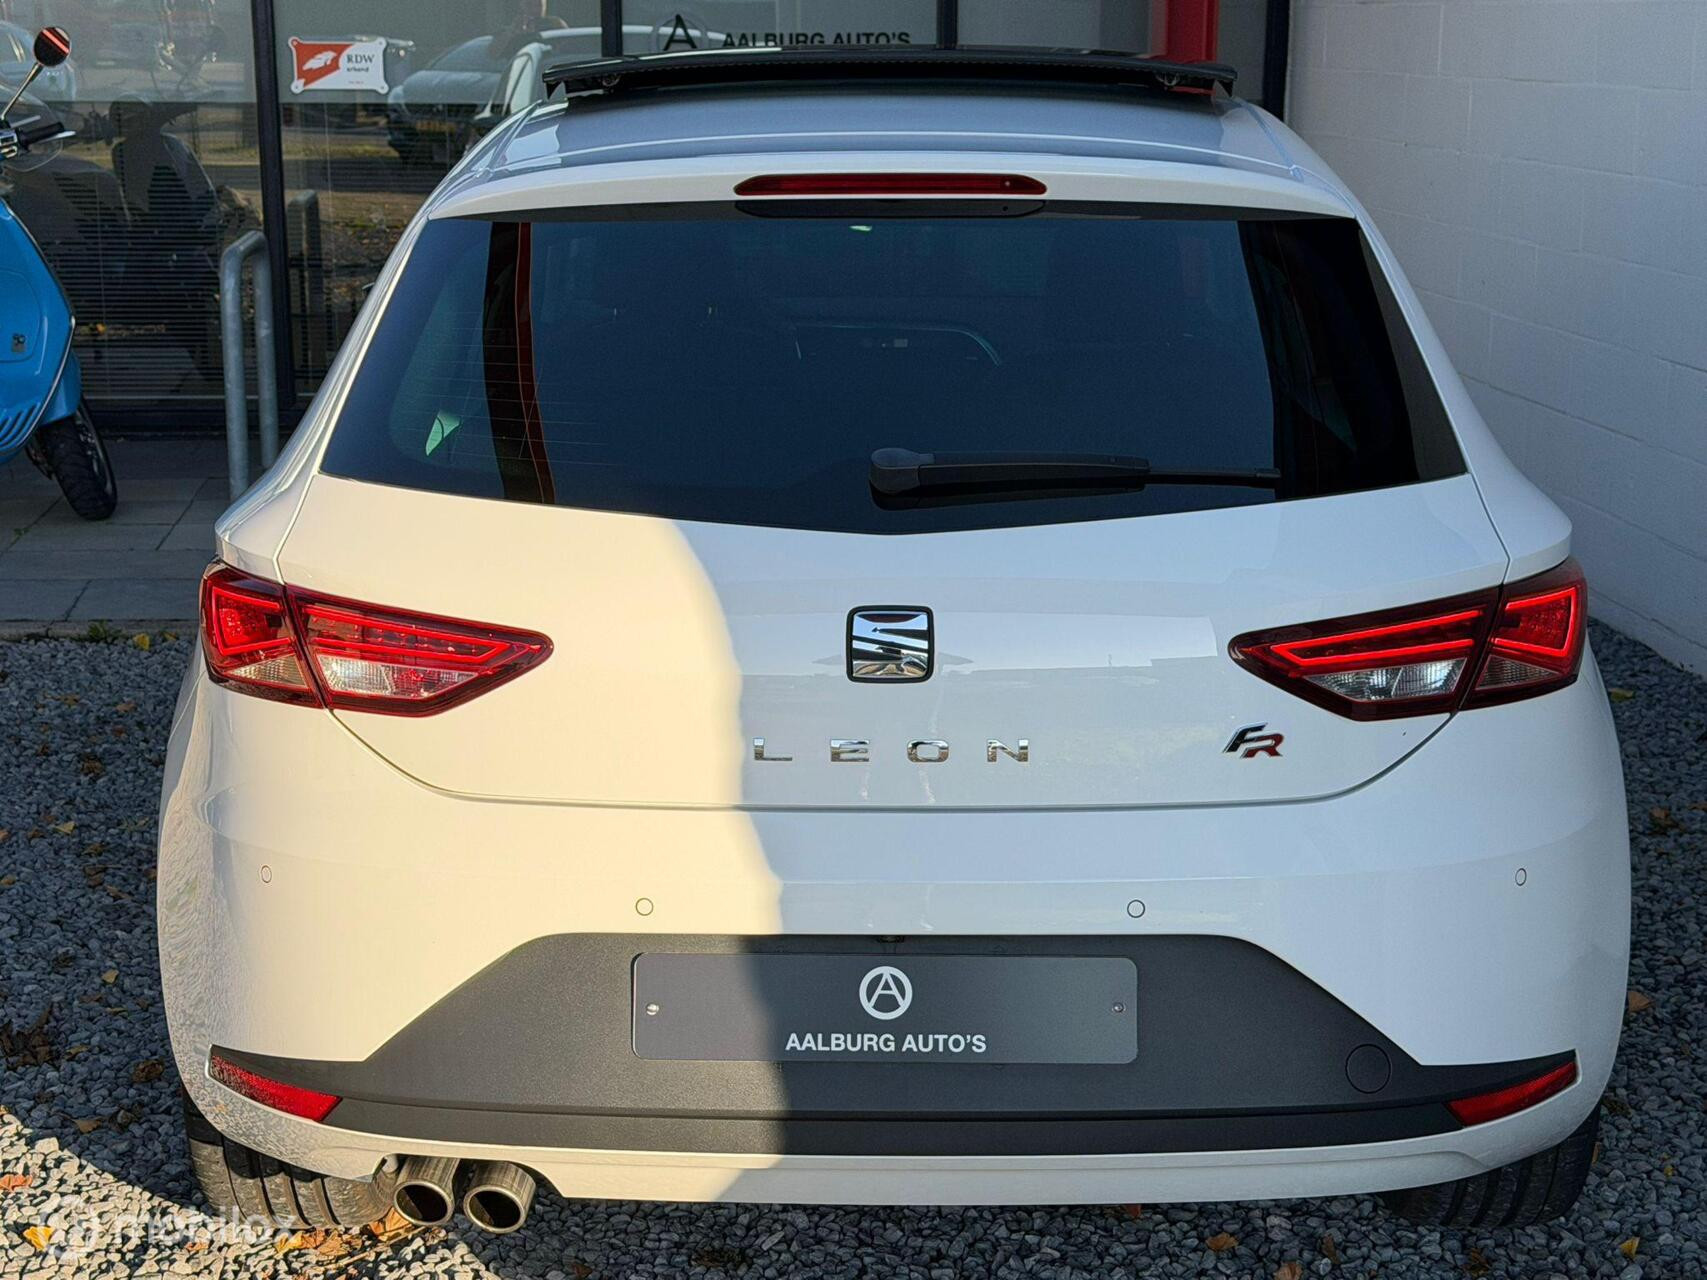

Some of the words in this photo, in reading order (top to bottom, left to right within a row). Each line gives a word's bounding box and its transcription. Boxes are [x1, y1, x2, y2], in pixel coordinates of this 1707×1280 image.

[722, 32, 825, 47] AALBURG
[833, 32, 911, 45] AUTO'S
[346, 54, 375, 64] RDW
[753, 738, 1029, 763] LEON
[1222, 721, 1284, 759] FR
[785, 1032, 896, 1052] AALBURG
[902, 1034, 987, 1053] AUTO'S
